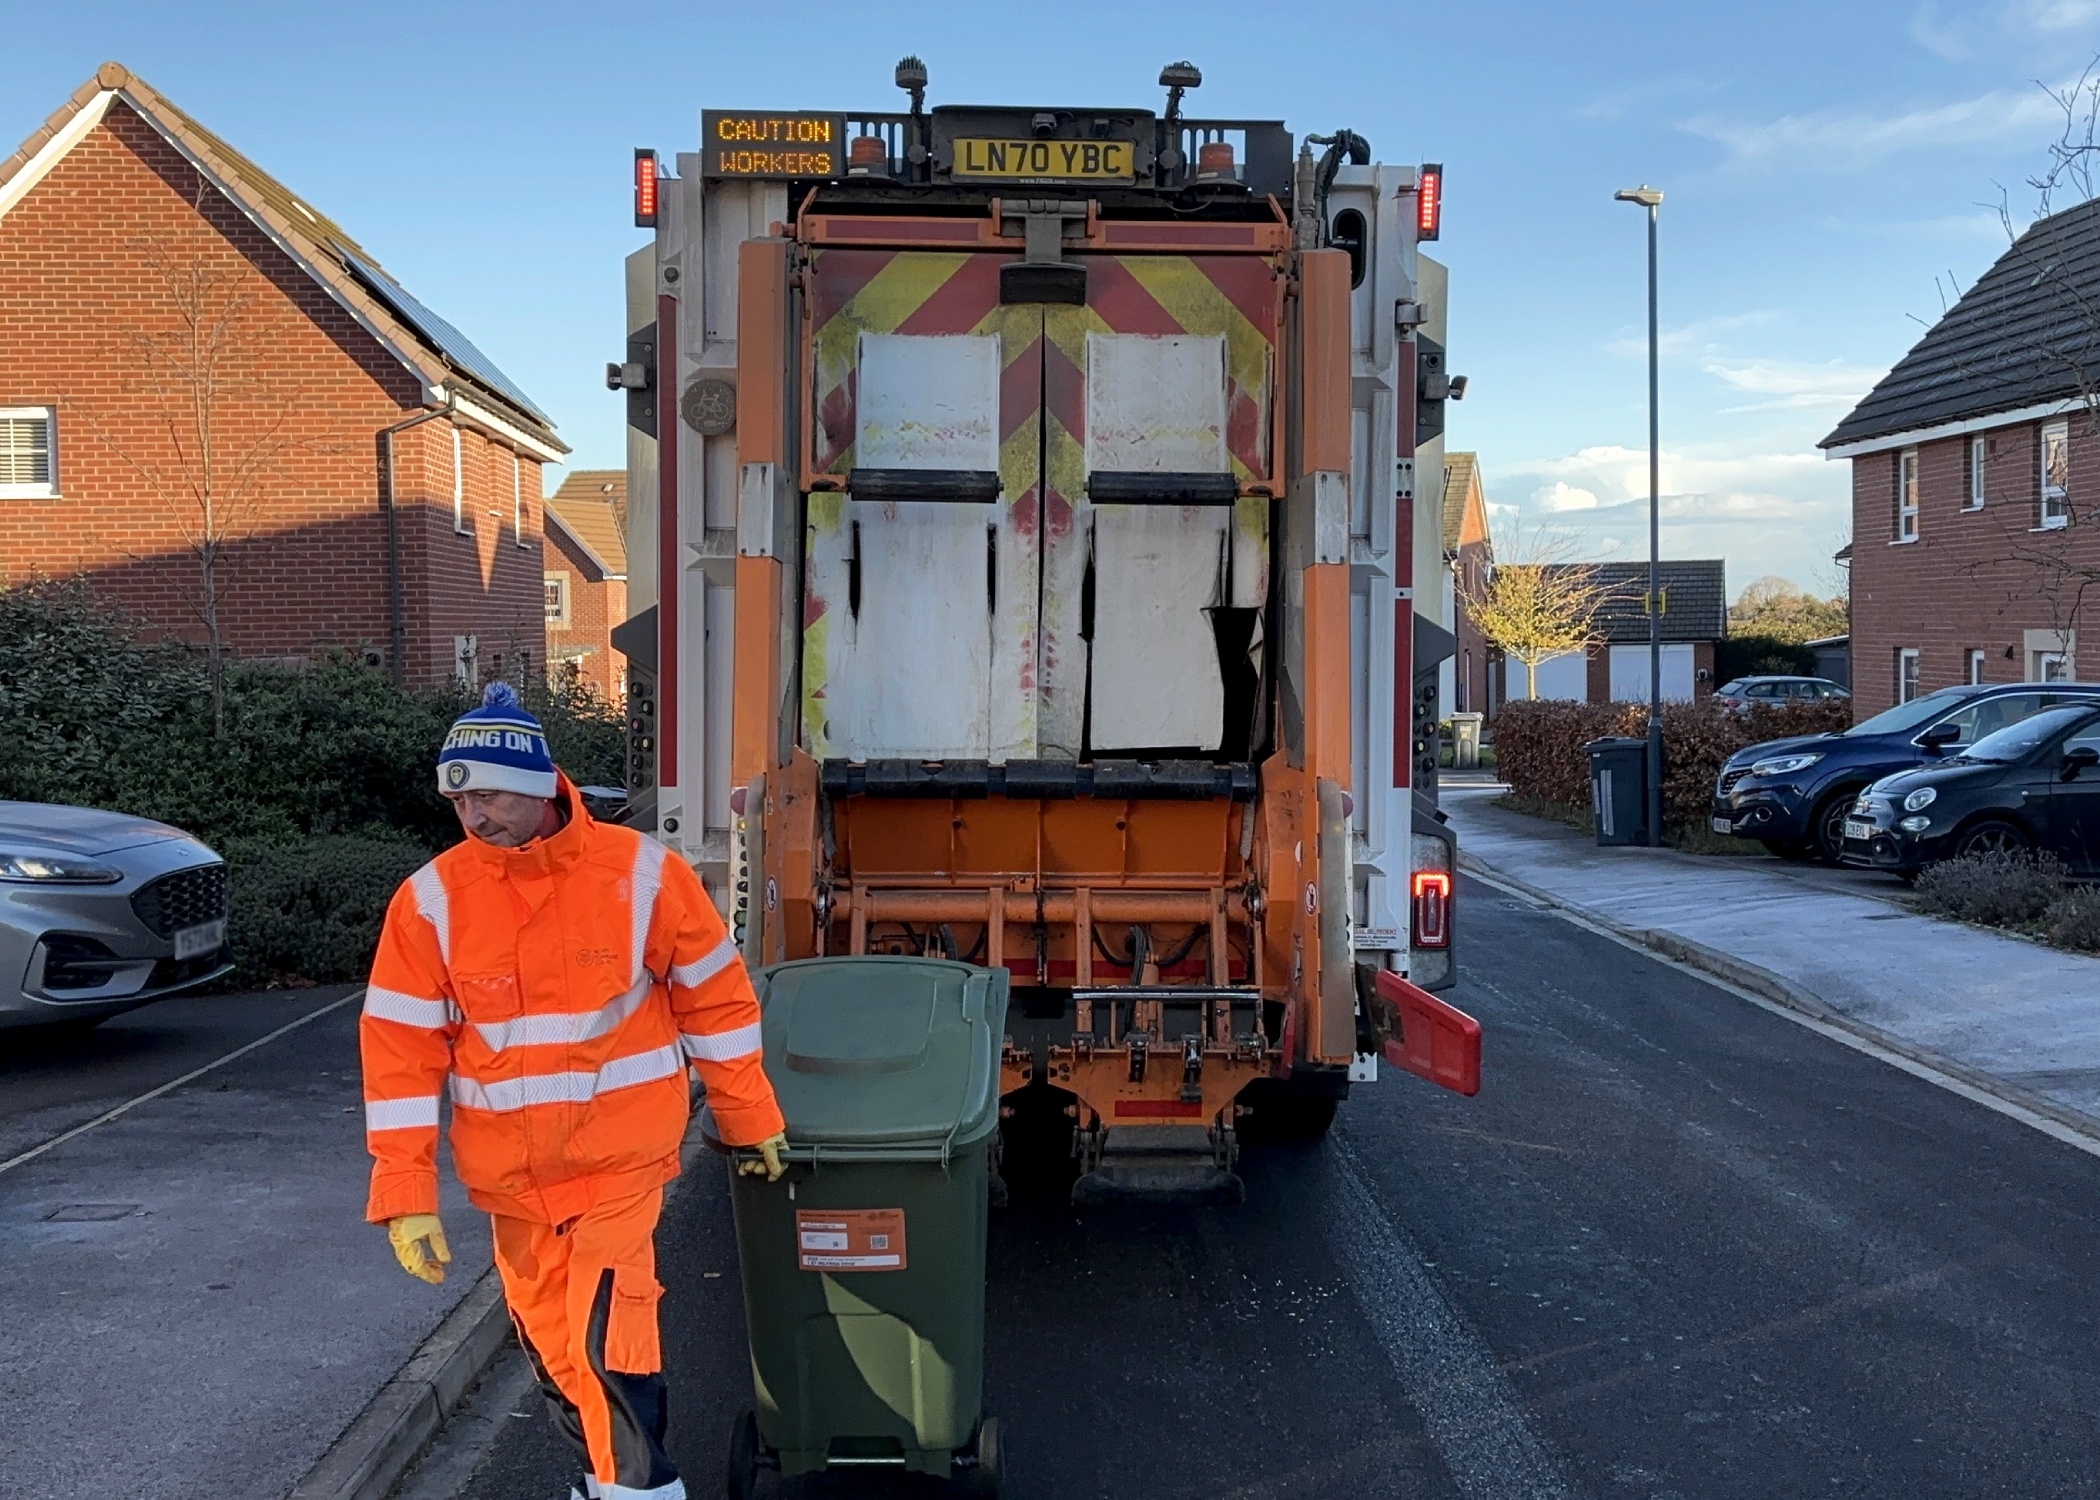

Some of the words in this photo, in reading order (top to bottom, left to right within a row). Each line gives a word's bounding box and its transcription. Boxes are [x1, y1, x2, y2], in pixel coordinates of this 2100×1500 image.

[718, 119, 830, 142] CAUTION
[719, 151, 832, 174] WORKERS
[966, 141, 1050, 173] LN70
[1060, 143, 1122, 174] YBC
[505, 732, 534, 754] ON
